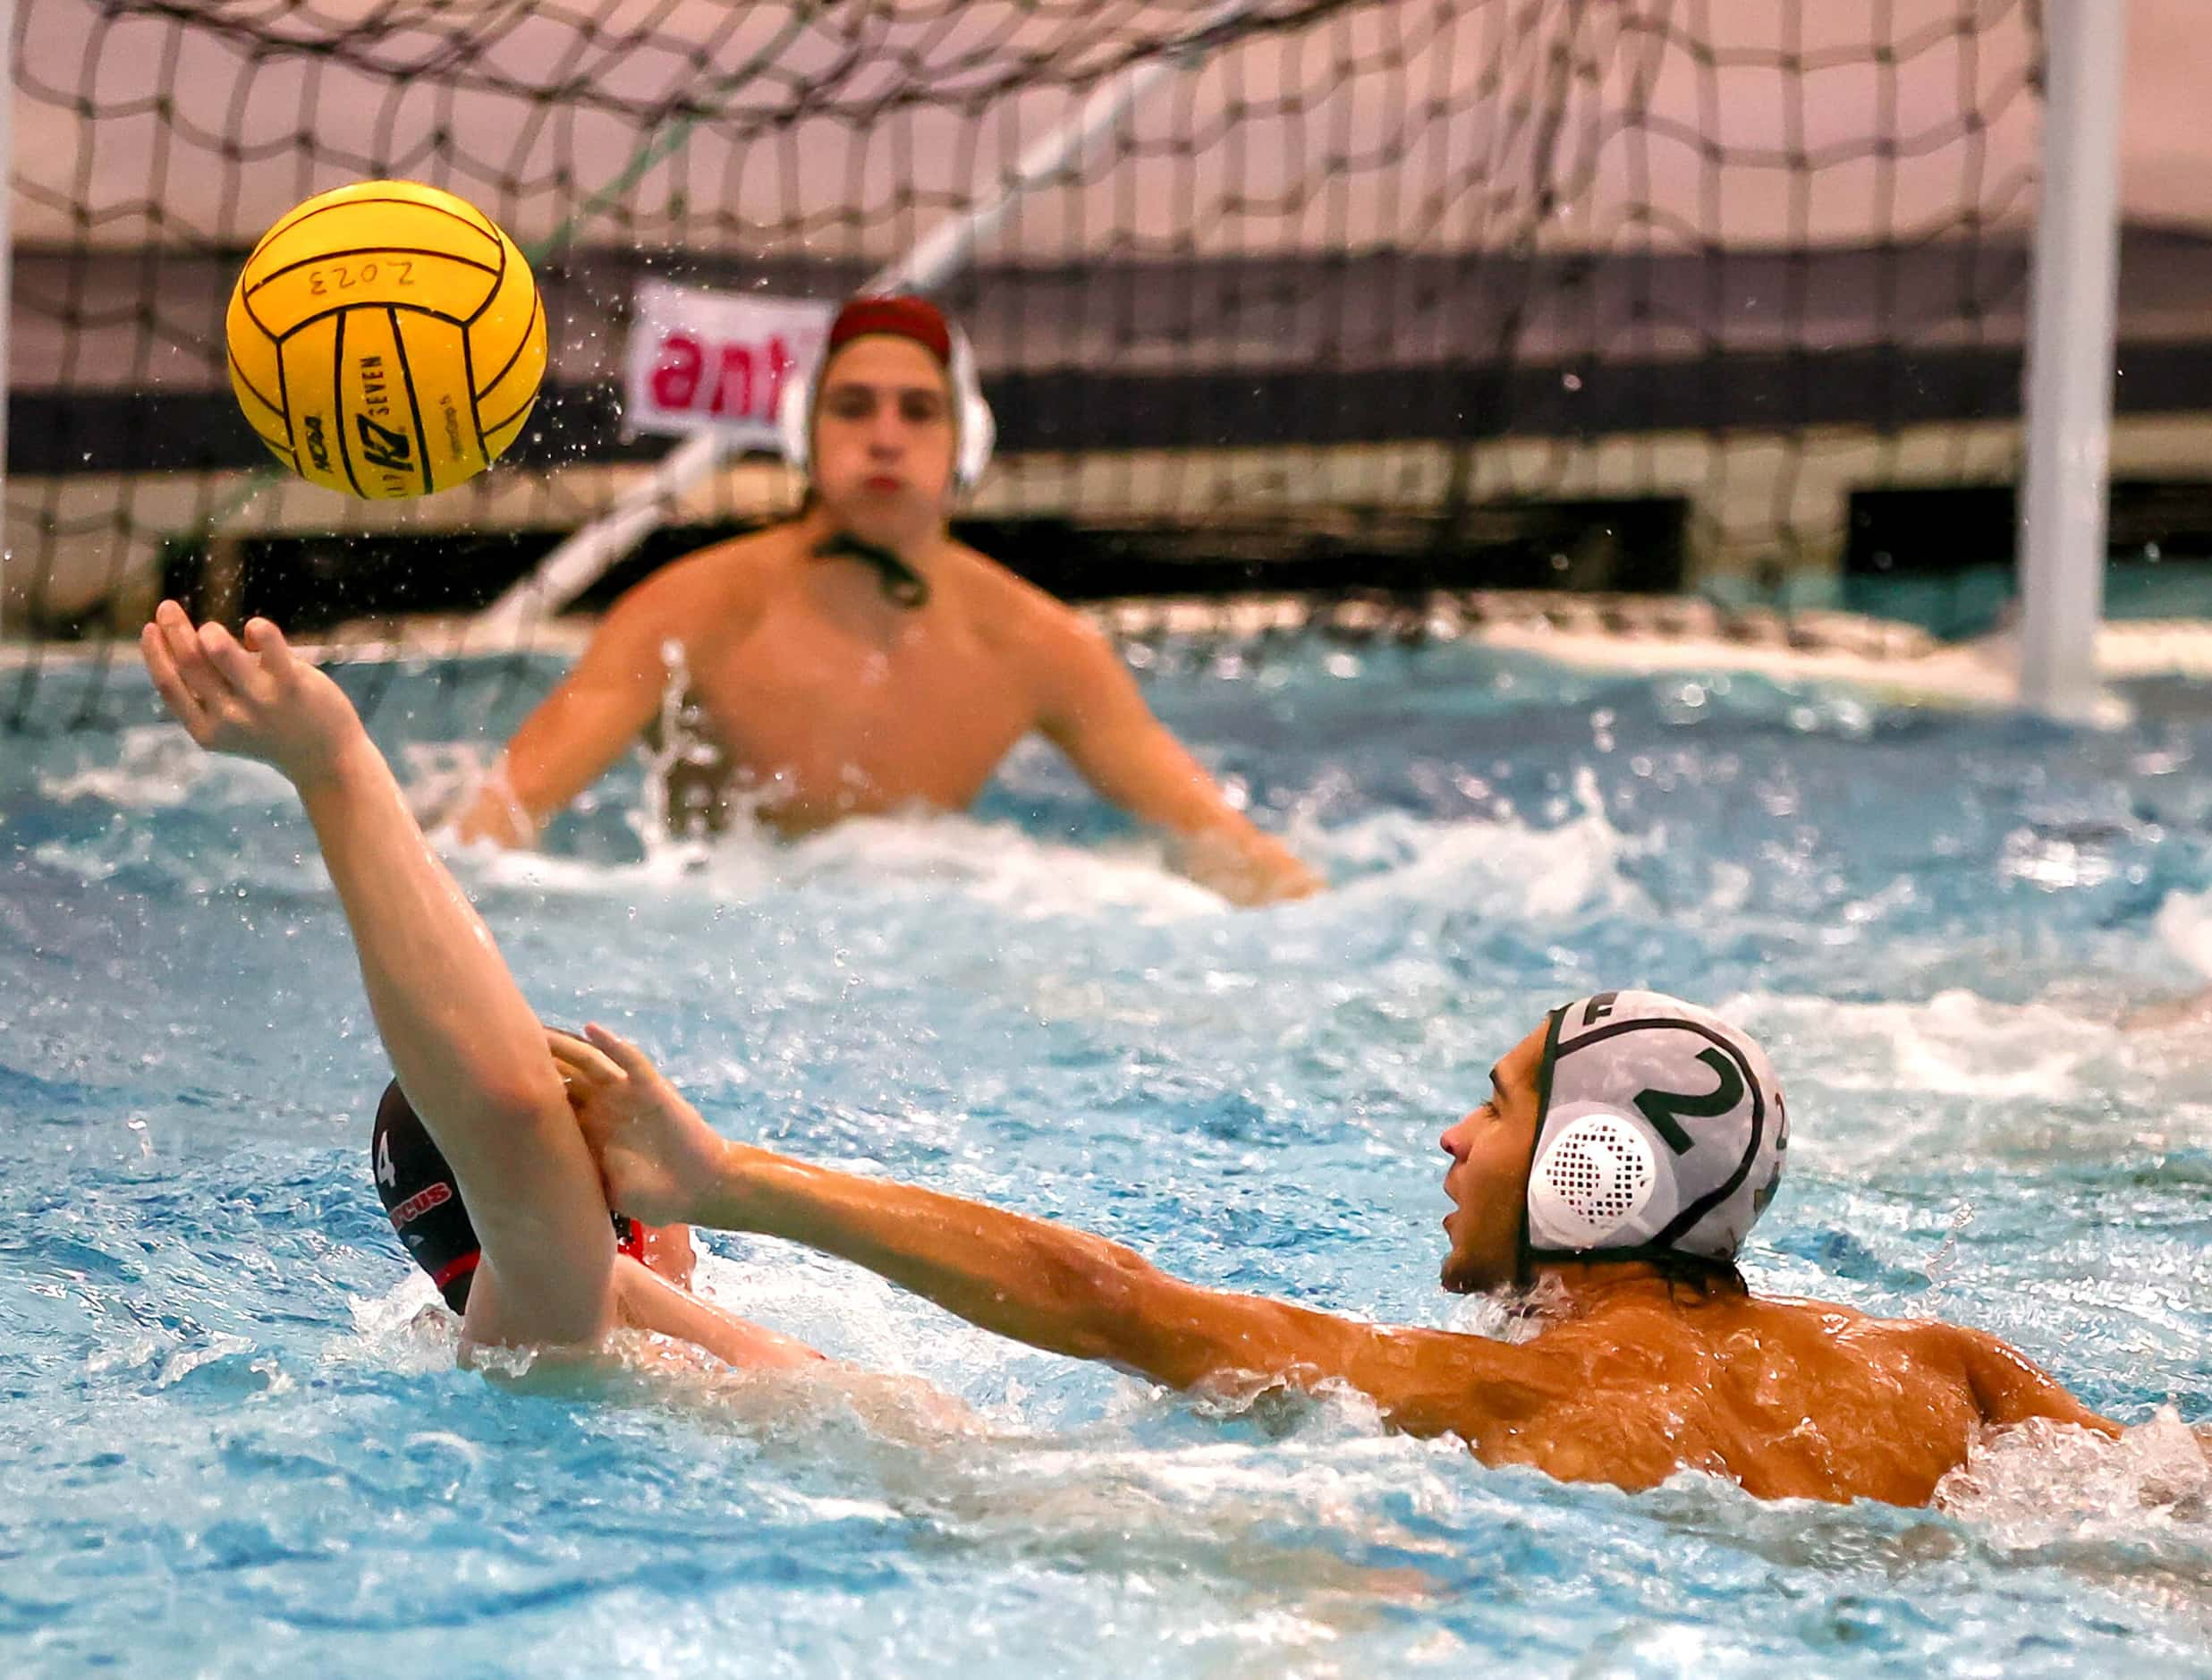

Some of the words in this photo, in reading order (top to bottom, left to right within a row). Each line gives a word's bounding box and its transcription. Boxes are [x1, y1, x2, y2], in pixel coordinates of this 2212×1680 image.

[309, 261, 415, 295] 2023
[360, 355, 390, 416] SEVEN
[1632, 1047, 1745, 1156] 2
[377, 1130, 396, 1188] 4
